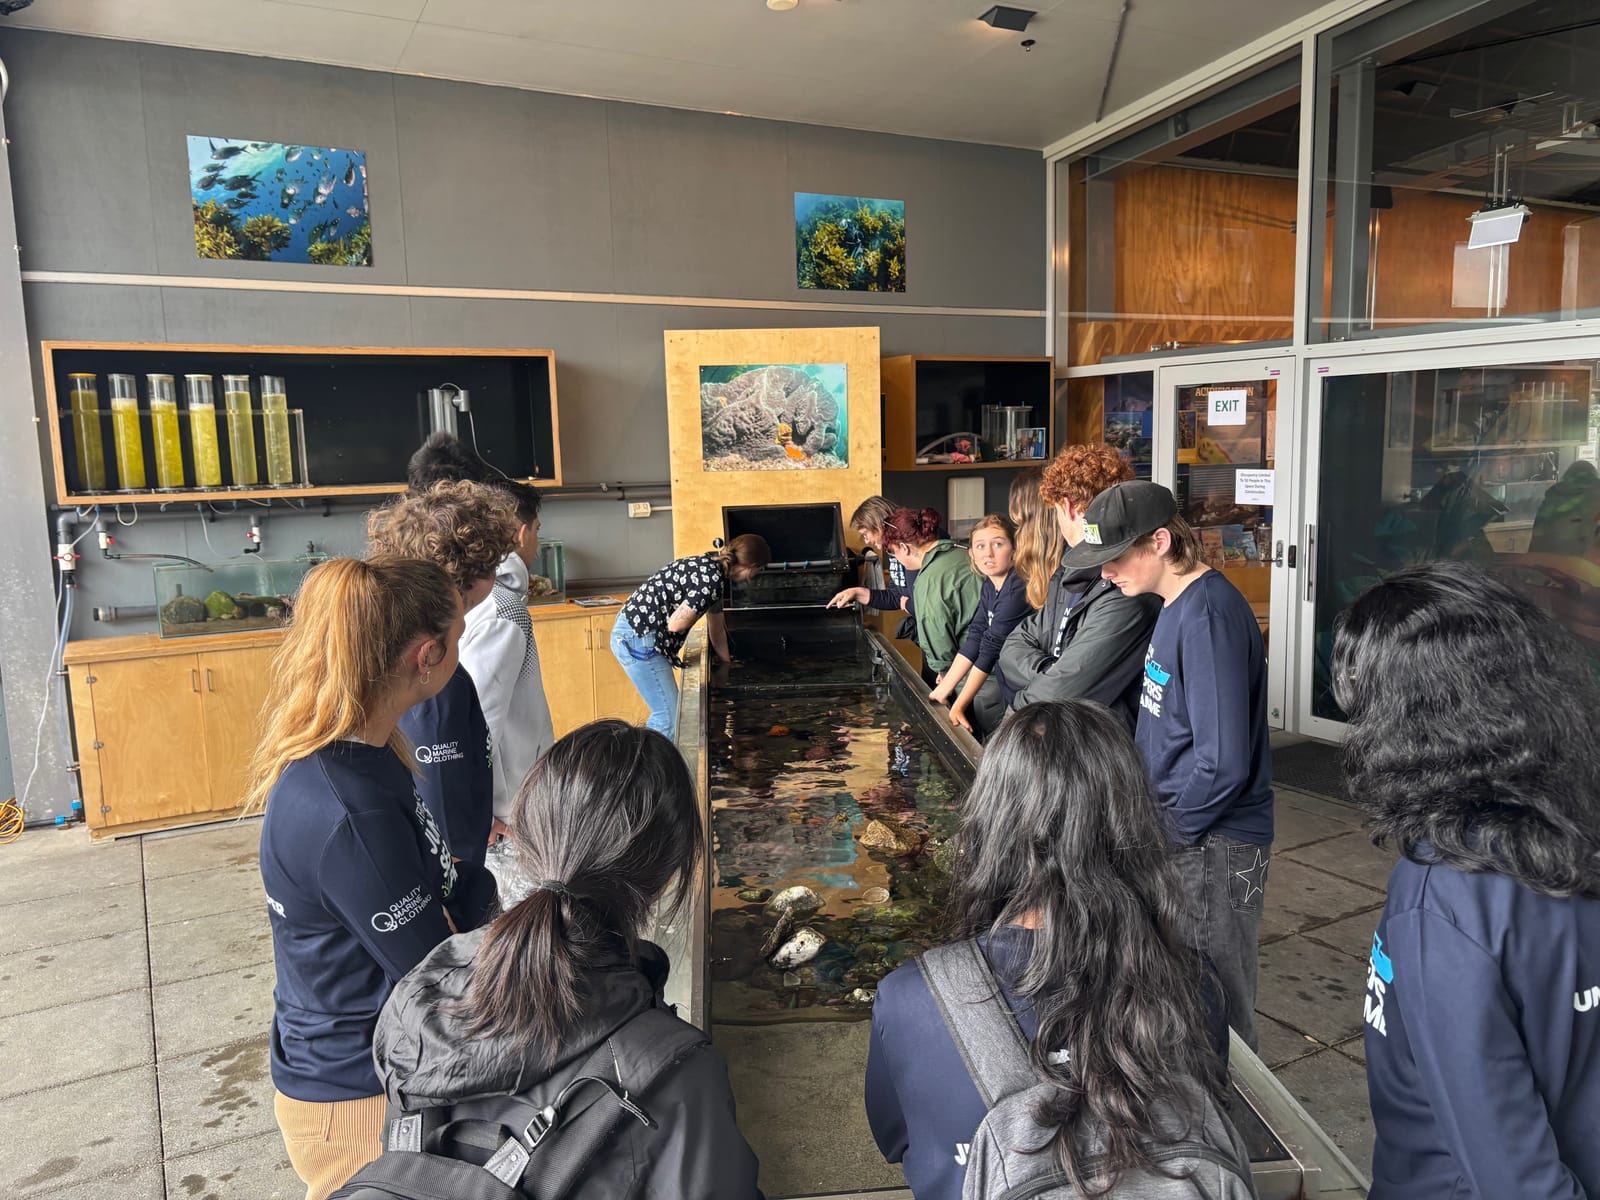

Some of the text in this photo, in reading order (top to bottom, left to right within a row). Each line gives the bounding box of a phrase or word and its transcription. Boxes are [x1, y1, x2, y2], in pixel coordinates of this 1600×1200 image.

[1215, 399, 1240, 412] EXIT
[432, 741, 459, 751] QUALITY
[432, 747, 457, 757] MARINE
[433, 752, 464, 763] CLOTHING
[389, 884, 421, 912] QUALITY
[392, 893, 423, 920] MARINE
[398, 894, 432, 925] CLOTHING
